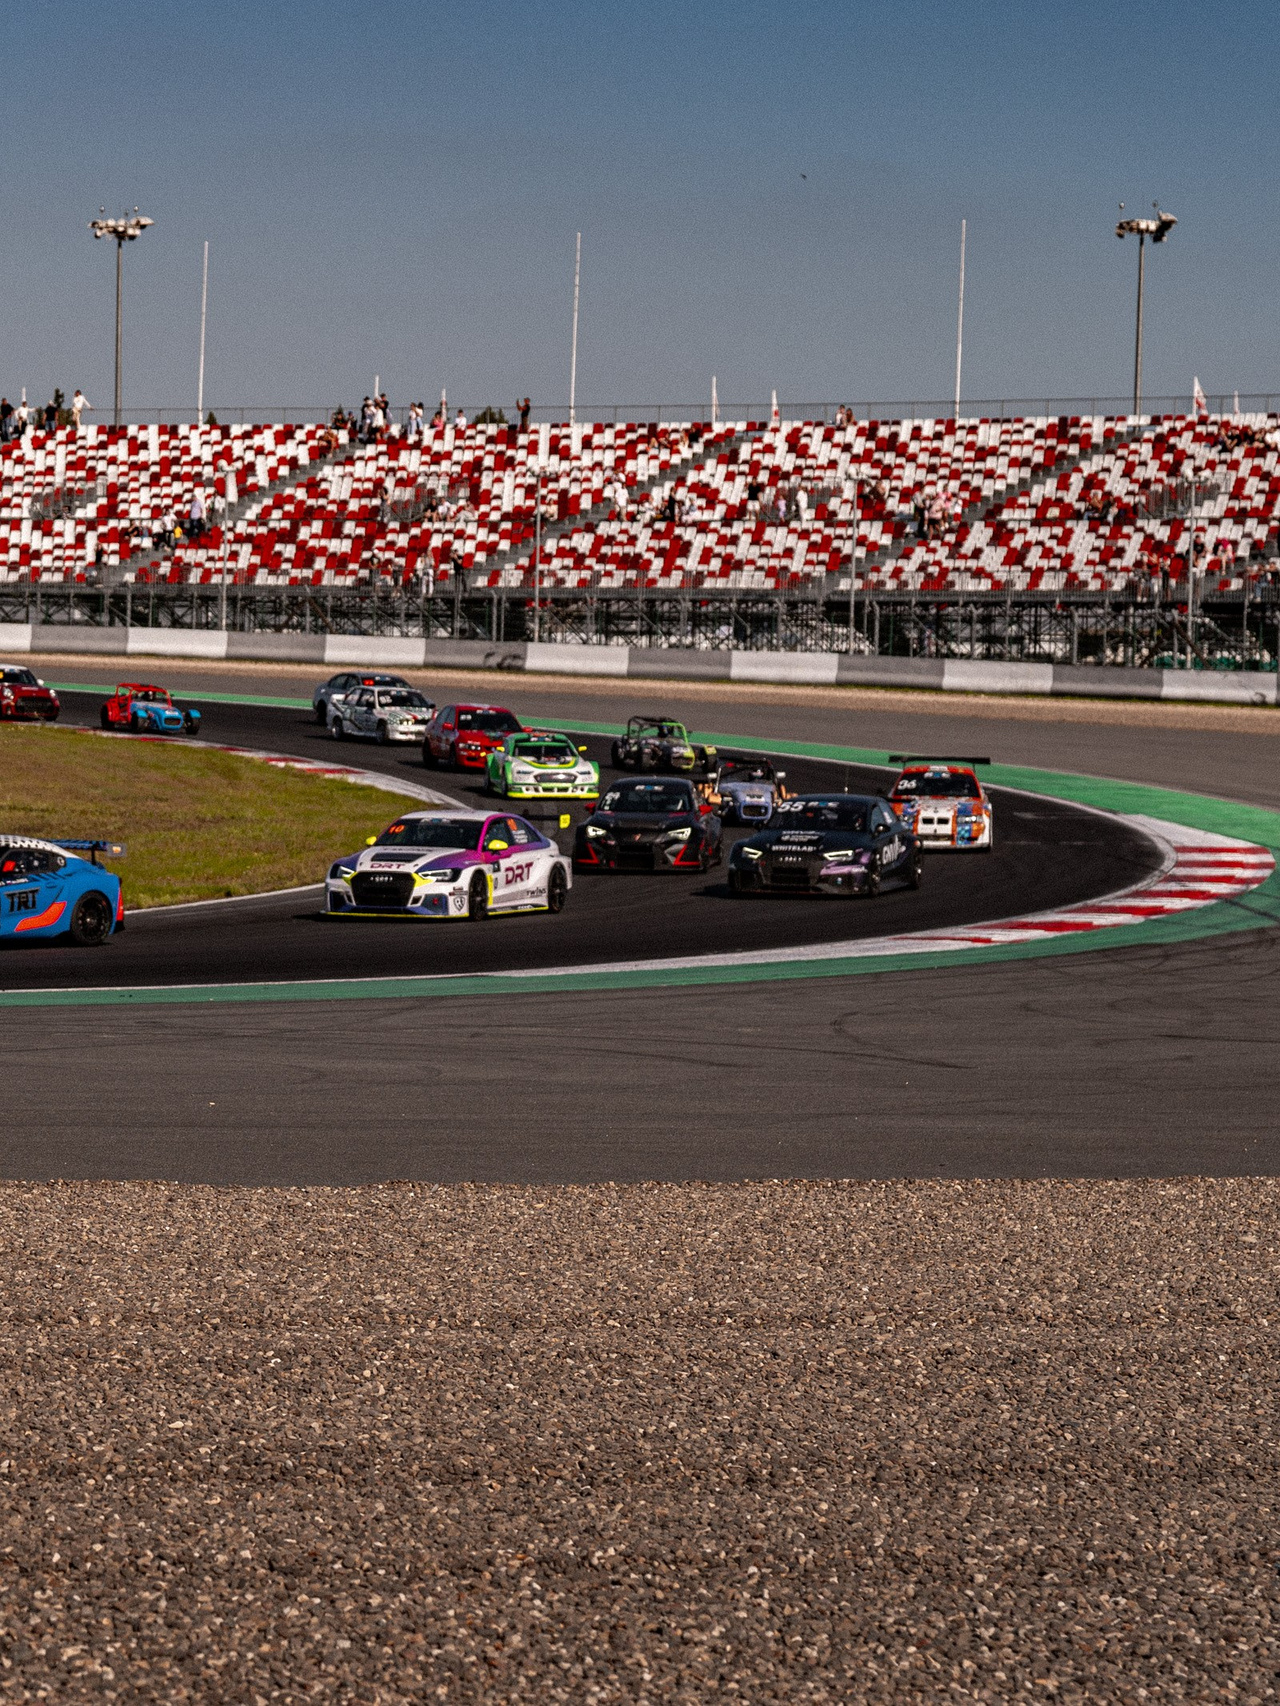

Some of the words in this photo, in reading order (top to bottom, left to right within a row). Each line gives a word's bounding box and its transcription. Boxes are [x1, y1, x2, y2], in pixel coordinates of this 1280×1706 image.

[776, 801, 806, 812] 55
[388, 825, 406, 834] 10
[504, 862, 534, 885] DRT
[4, 887, 41, 913] TRT
